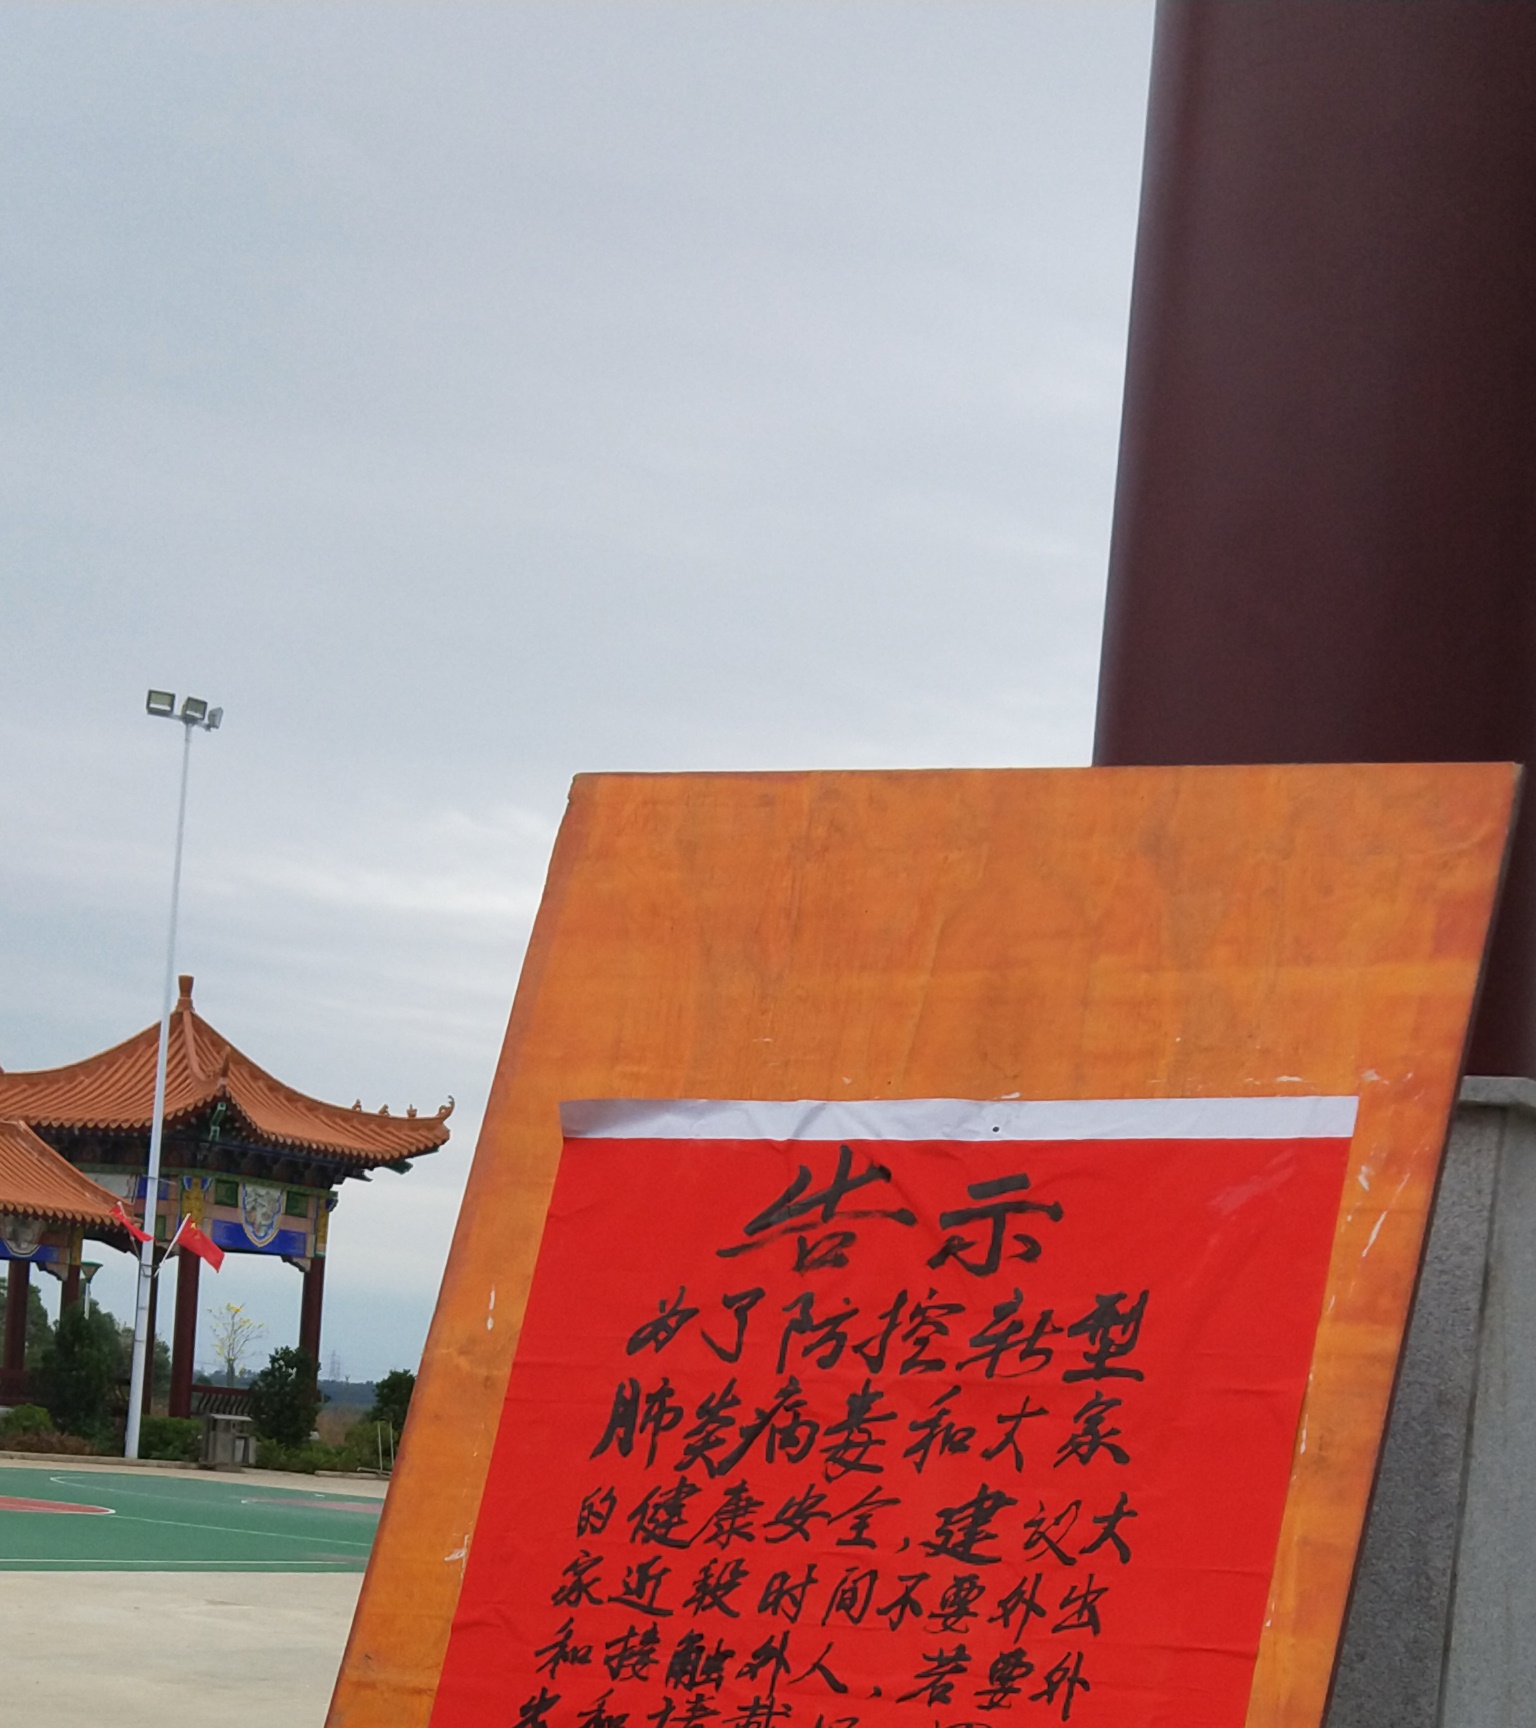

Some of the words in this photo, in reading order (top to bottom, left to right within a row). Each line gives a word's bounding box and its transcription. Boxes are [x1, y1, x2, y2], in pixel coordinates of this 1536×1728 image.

[716, 1143, 1064, 1278] 告示
[626, 1286, 1150, 1384] 为了防控新型
[590, 1376, 1131, 1484] 肺炎病毒和大家
[550, 1555, 1109, 1645] 家近段时间不要外出
